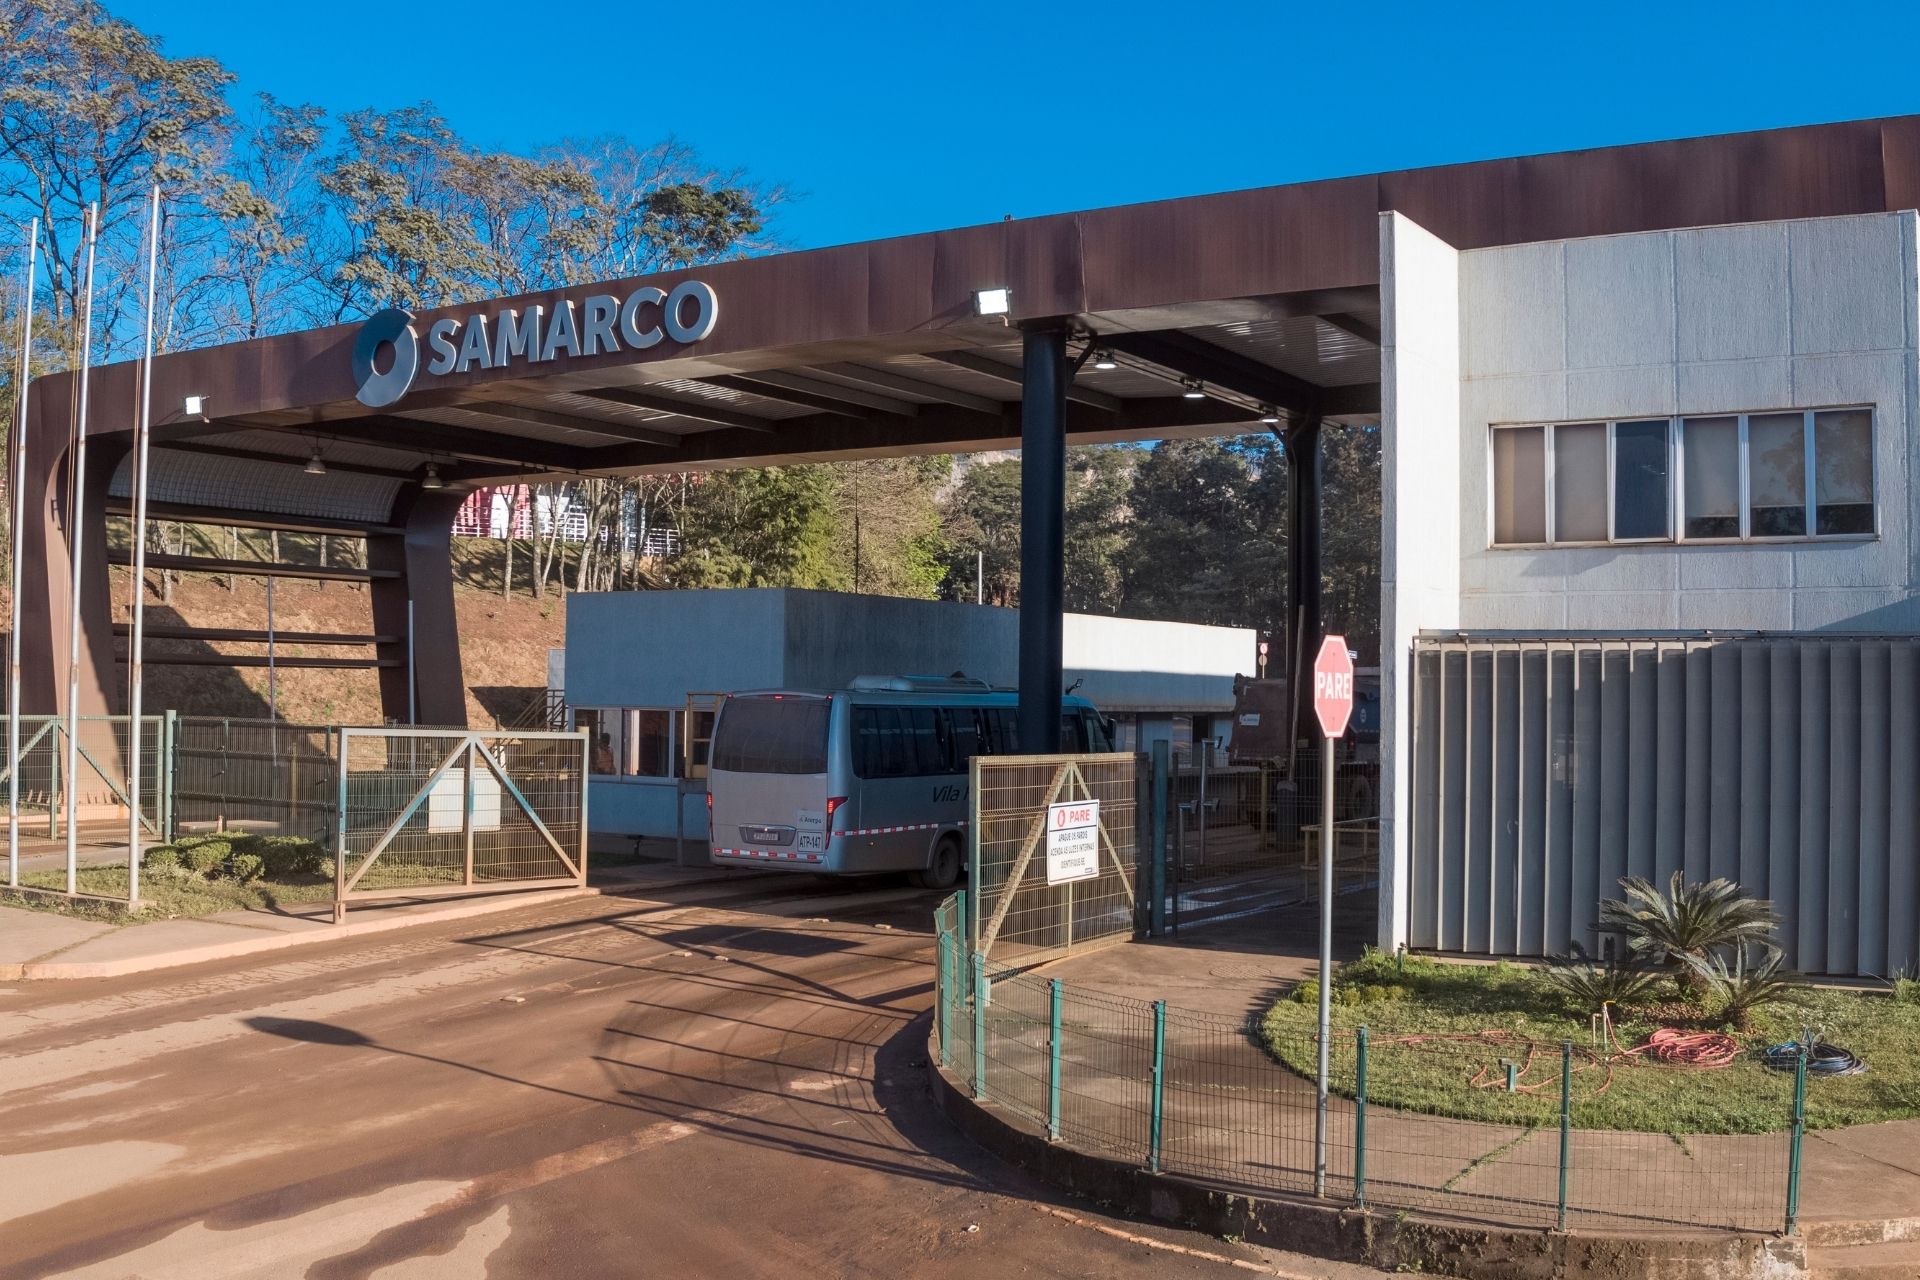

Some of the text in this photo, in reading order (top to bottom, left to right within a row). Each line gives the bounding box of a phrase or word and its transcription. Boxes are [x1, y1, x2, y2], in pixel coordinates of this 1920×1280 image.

[427, 280, 719, 376] SAMARCO
[1317, 671, 1351, 700] PARE
[933, 785, 960, 802] Vila
[1069, 809, 1090, 822] PARE
